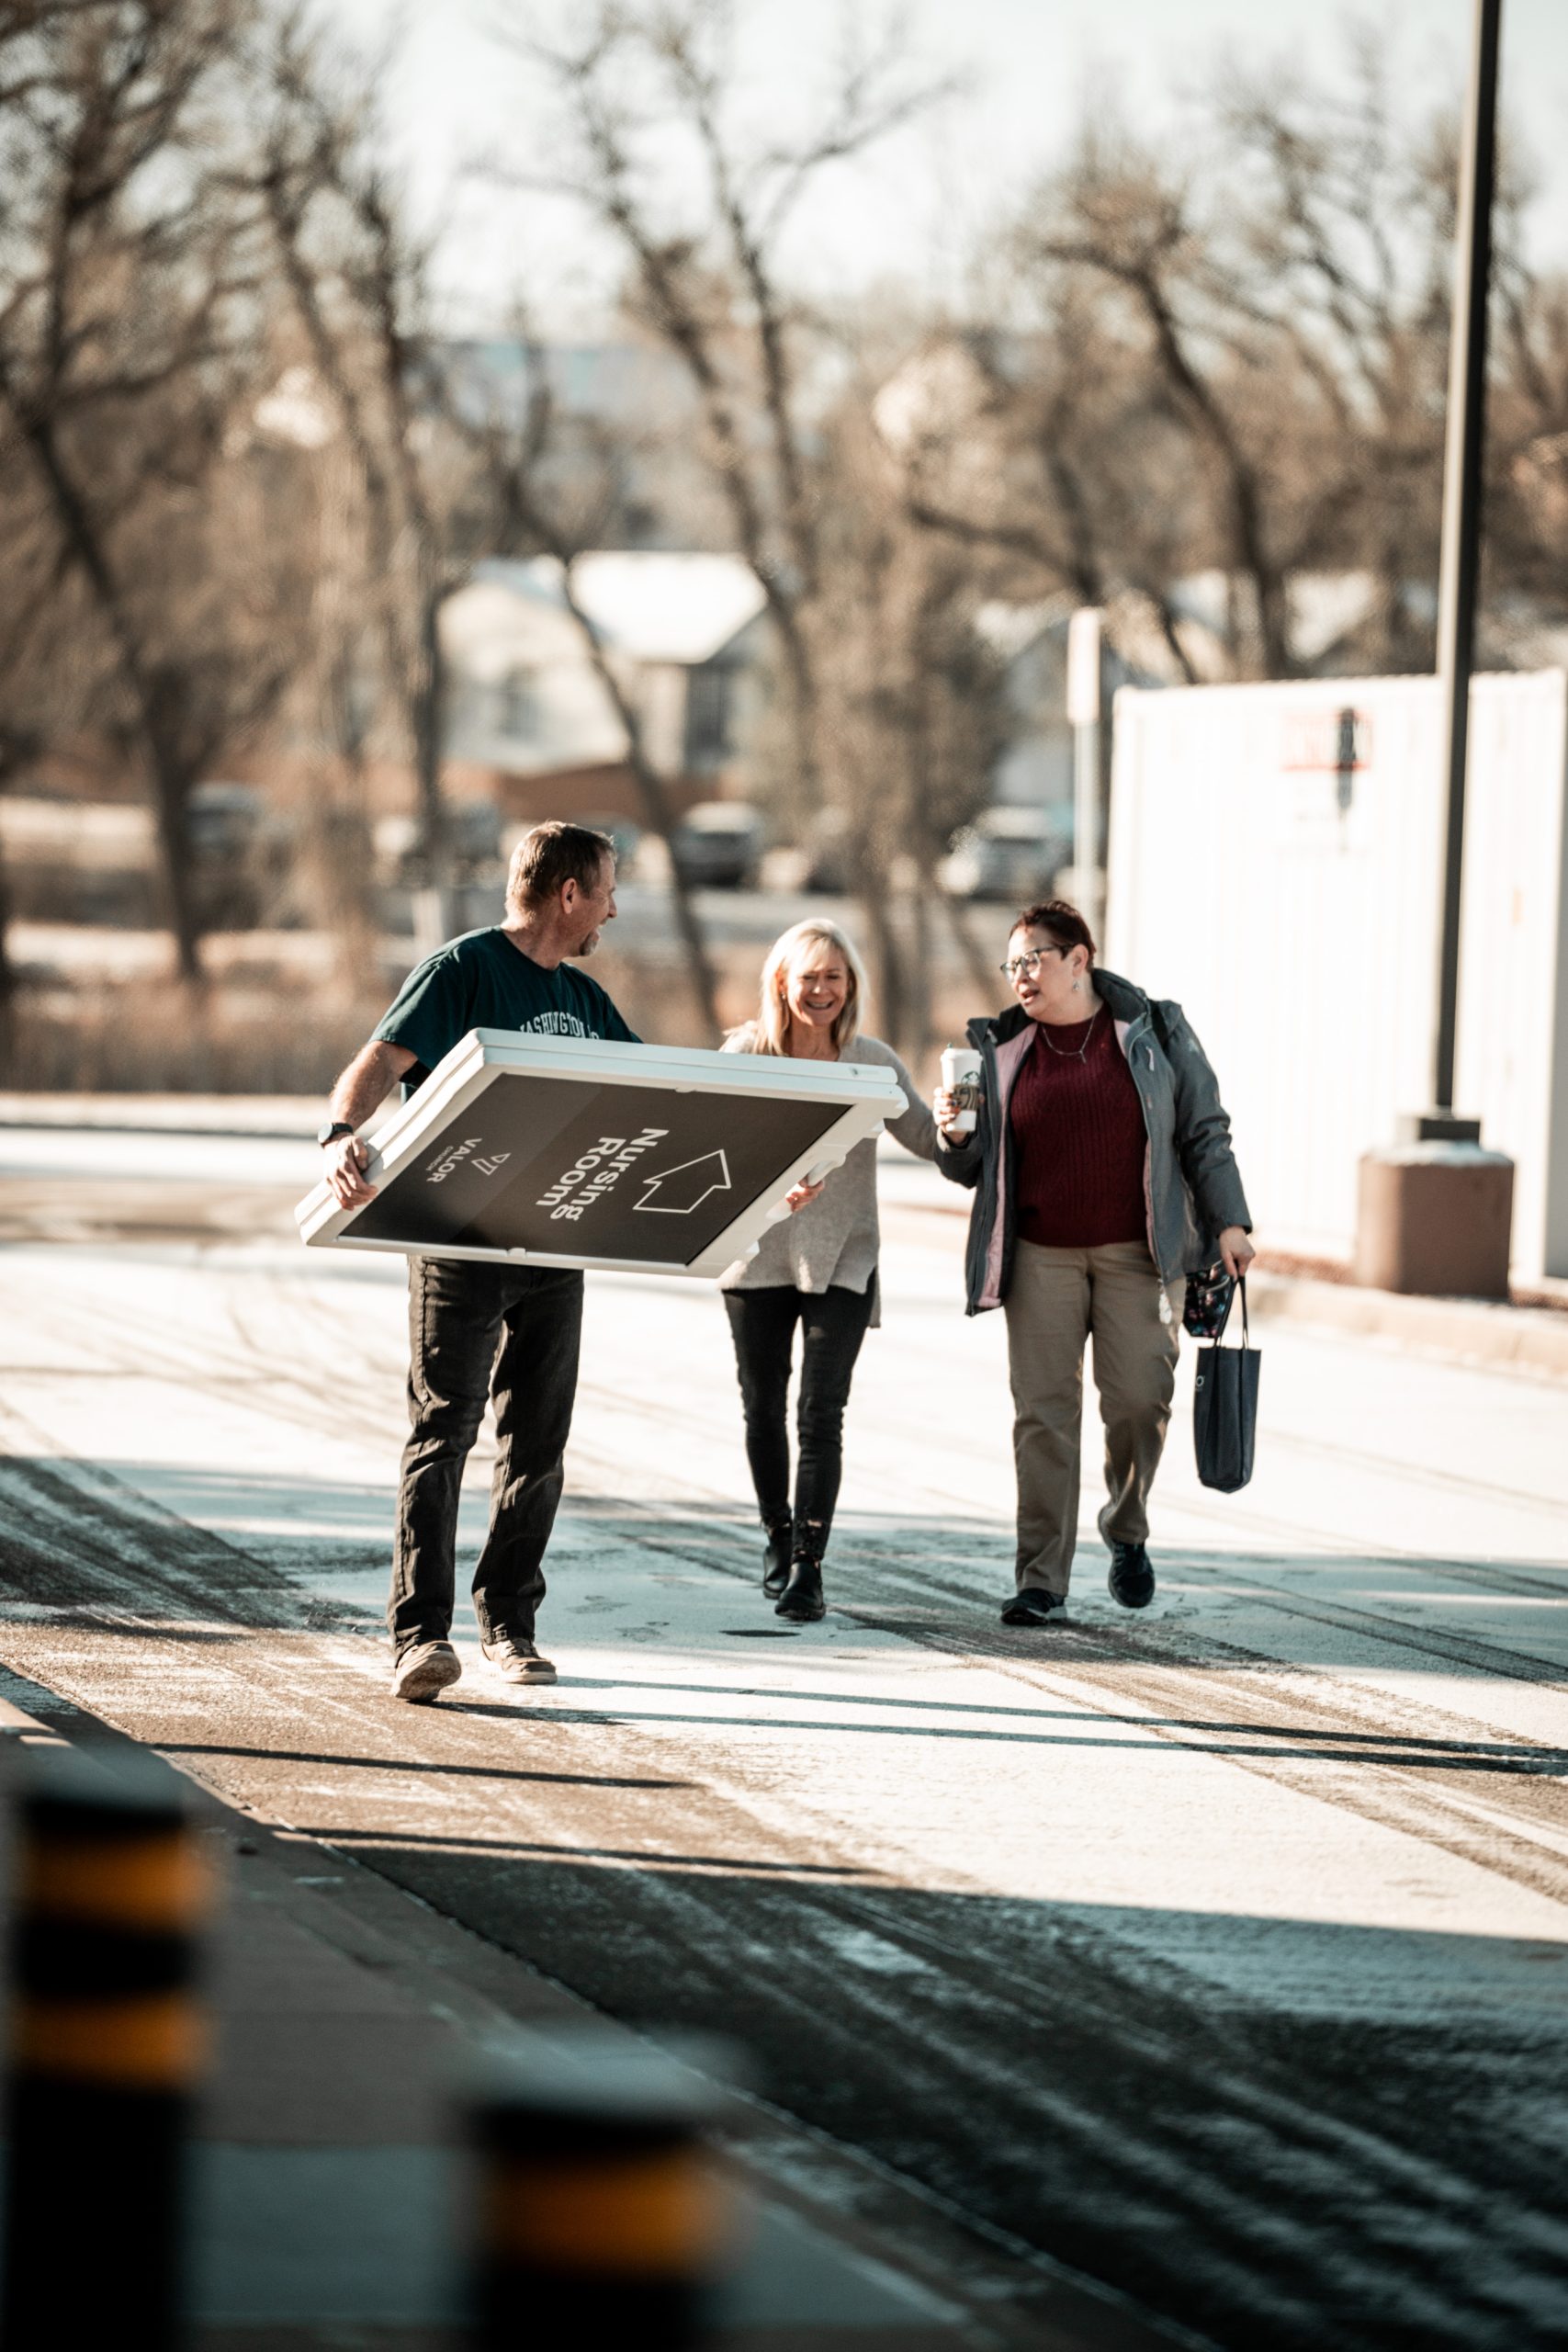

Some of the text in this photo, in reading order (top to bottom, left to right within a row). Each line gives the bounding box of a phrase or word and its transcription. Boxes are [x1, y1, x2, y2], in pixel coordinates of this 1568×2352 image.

[426, 1137, 483, 1182] VALOR
[536, 1136, 626, 1206] Room
[550, 1128, 670, 1222] Nursing
